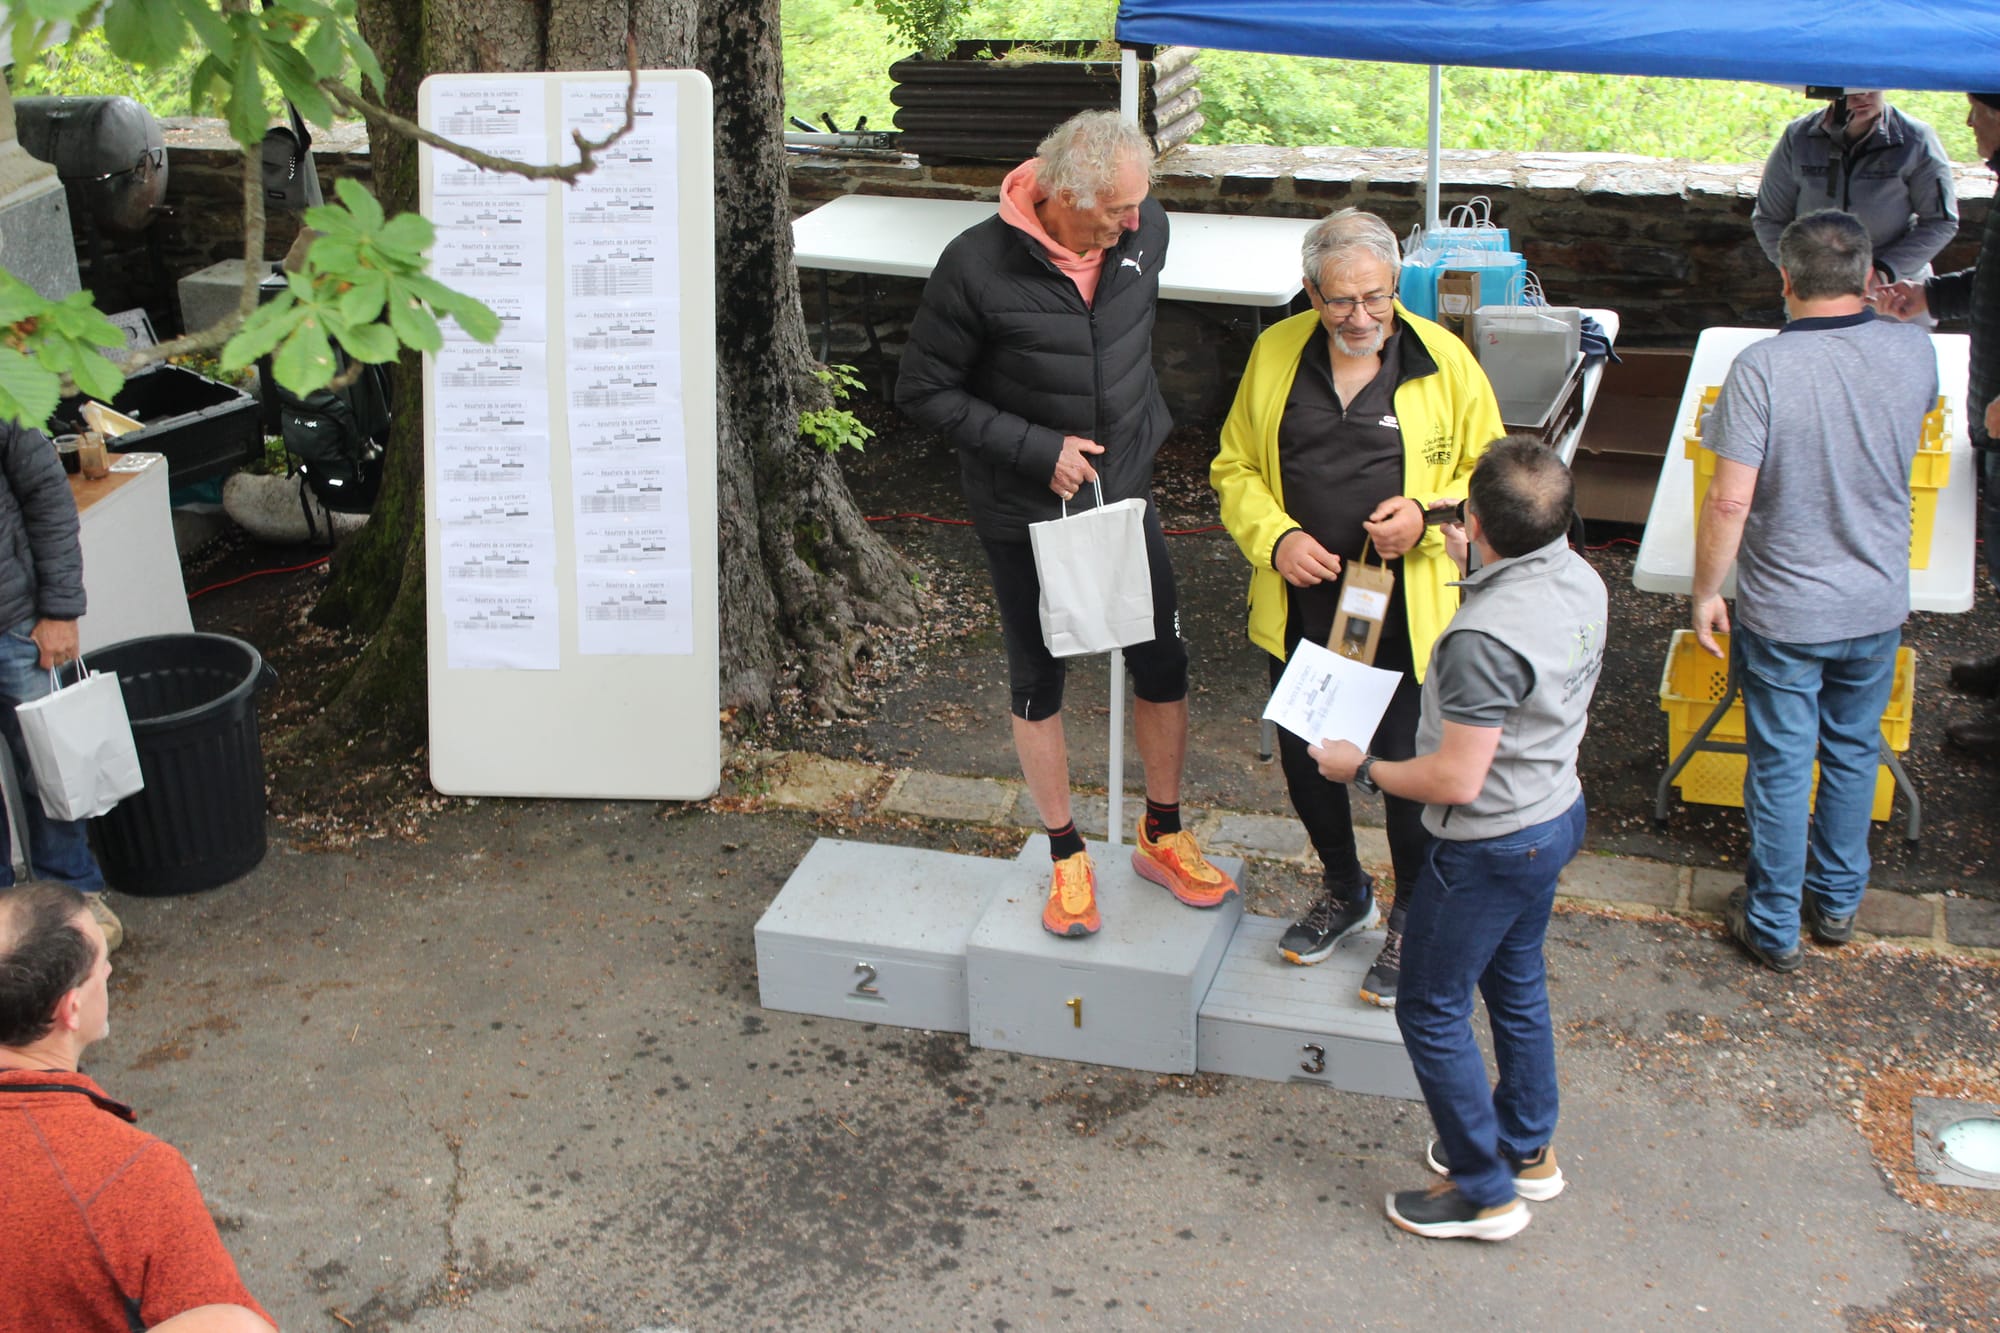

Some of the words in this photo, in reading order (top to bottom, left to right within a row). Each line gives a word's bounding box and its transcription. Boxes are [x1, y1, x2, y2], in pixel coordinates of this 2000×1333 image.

[854, 962, 879, 995] 2
[1066, 996, 1082, 1028] 1
[1302, 1043, 1326, 1074] 3
